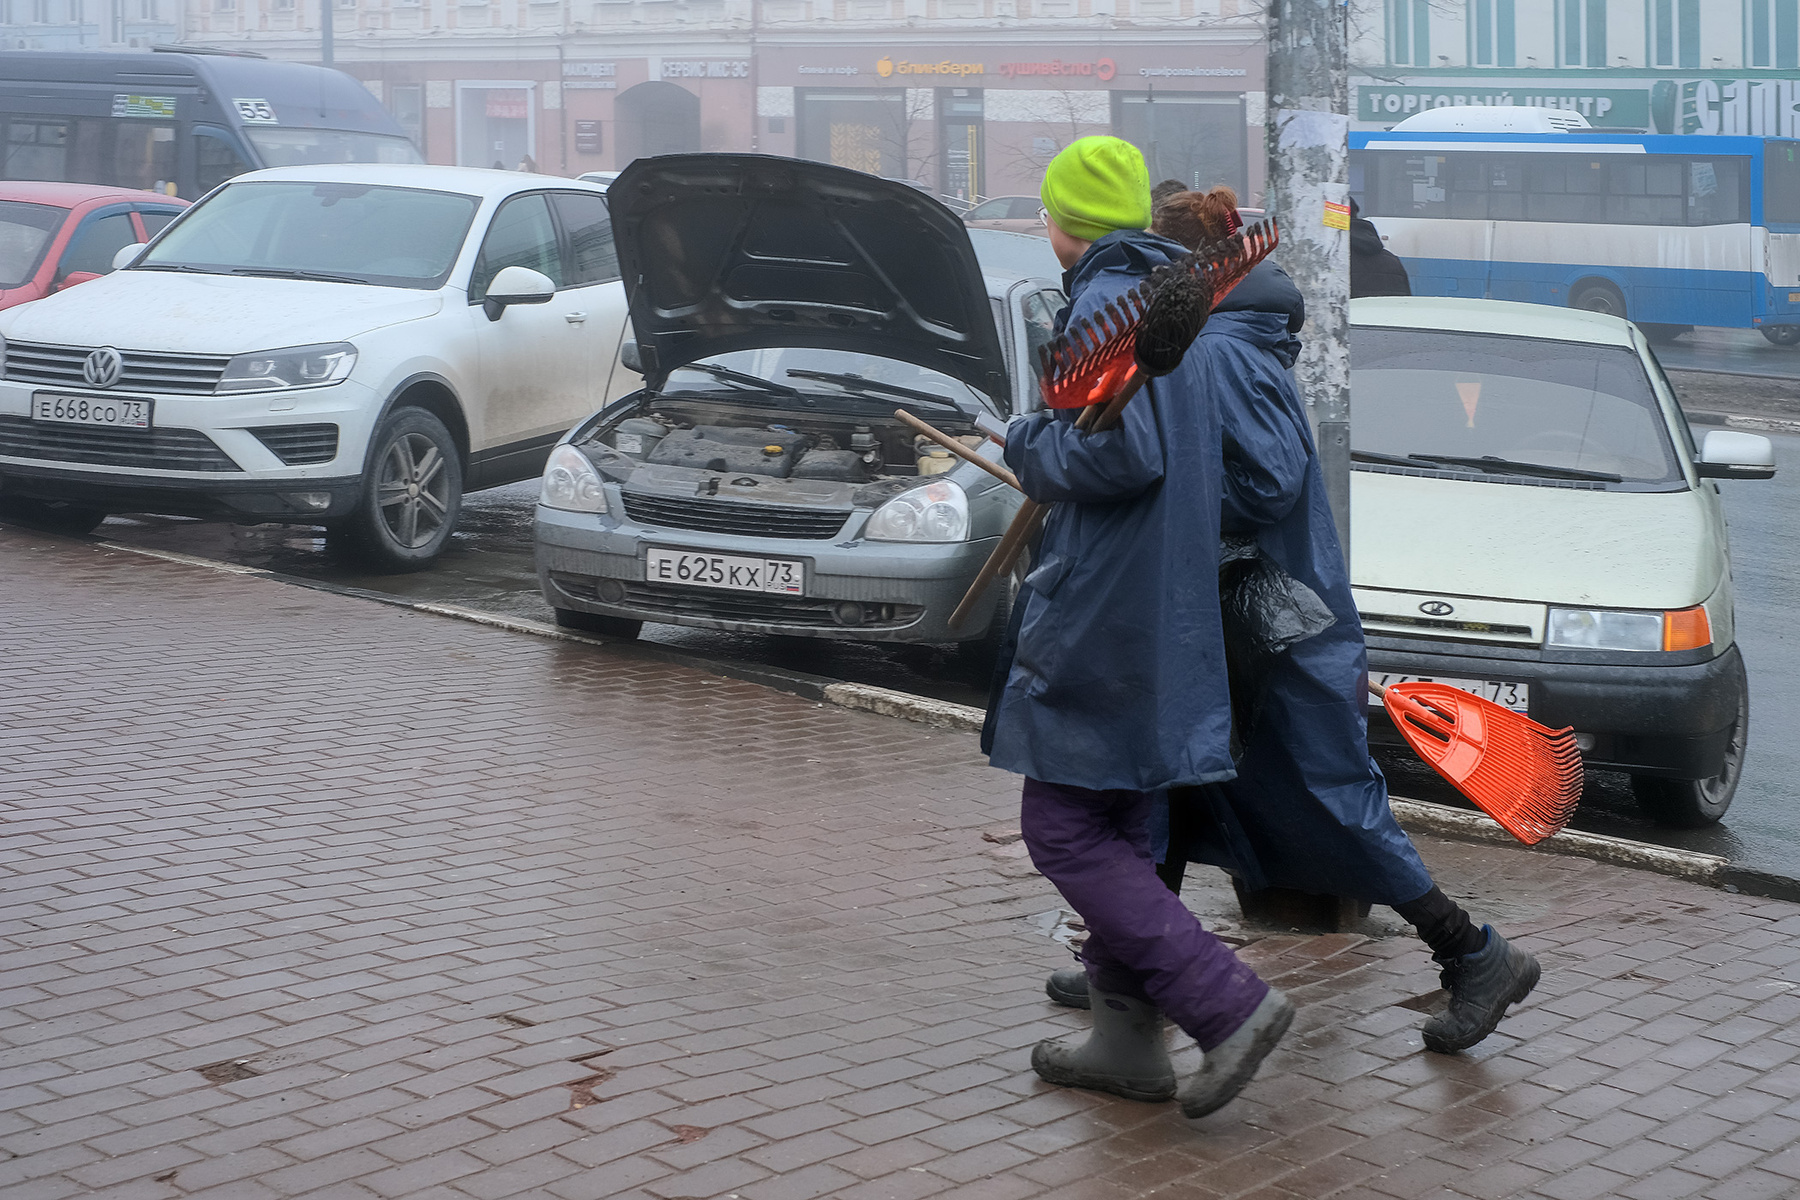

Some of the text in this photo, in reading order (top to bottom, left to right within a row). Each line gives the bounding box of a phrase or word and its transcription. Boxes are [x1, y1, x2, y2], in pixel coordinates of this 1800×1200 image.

[662, 61, 706, 78] СЕРВИС
[897, 60, 984, 77] блинбери
[239, 102, 271, 119] 55
[1369, 91, 1612, 117] ТОРГОВЫЙ ЦЕНТР
[122, 402, 142, 418] 73
[658, 555, 793, 588] Е625КХ 73
[1488, 681, 1519, 705] 73
